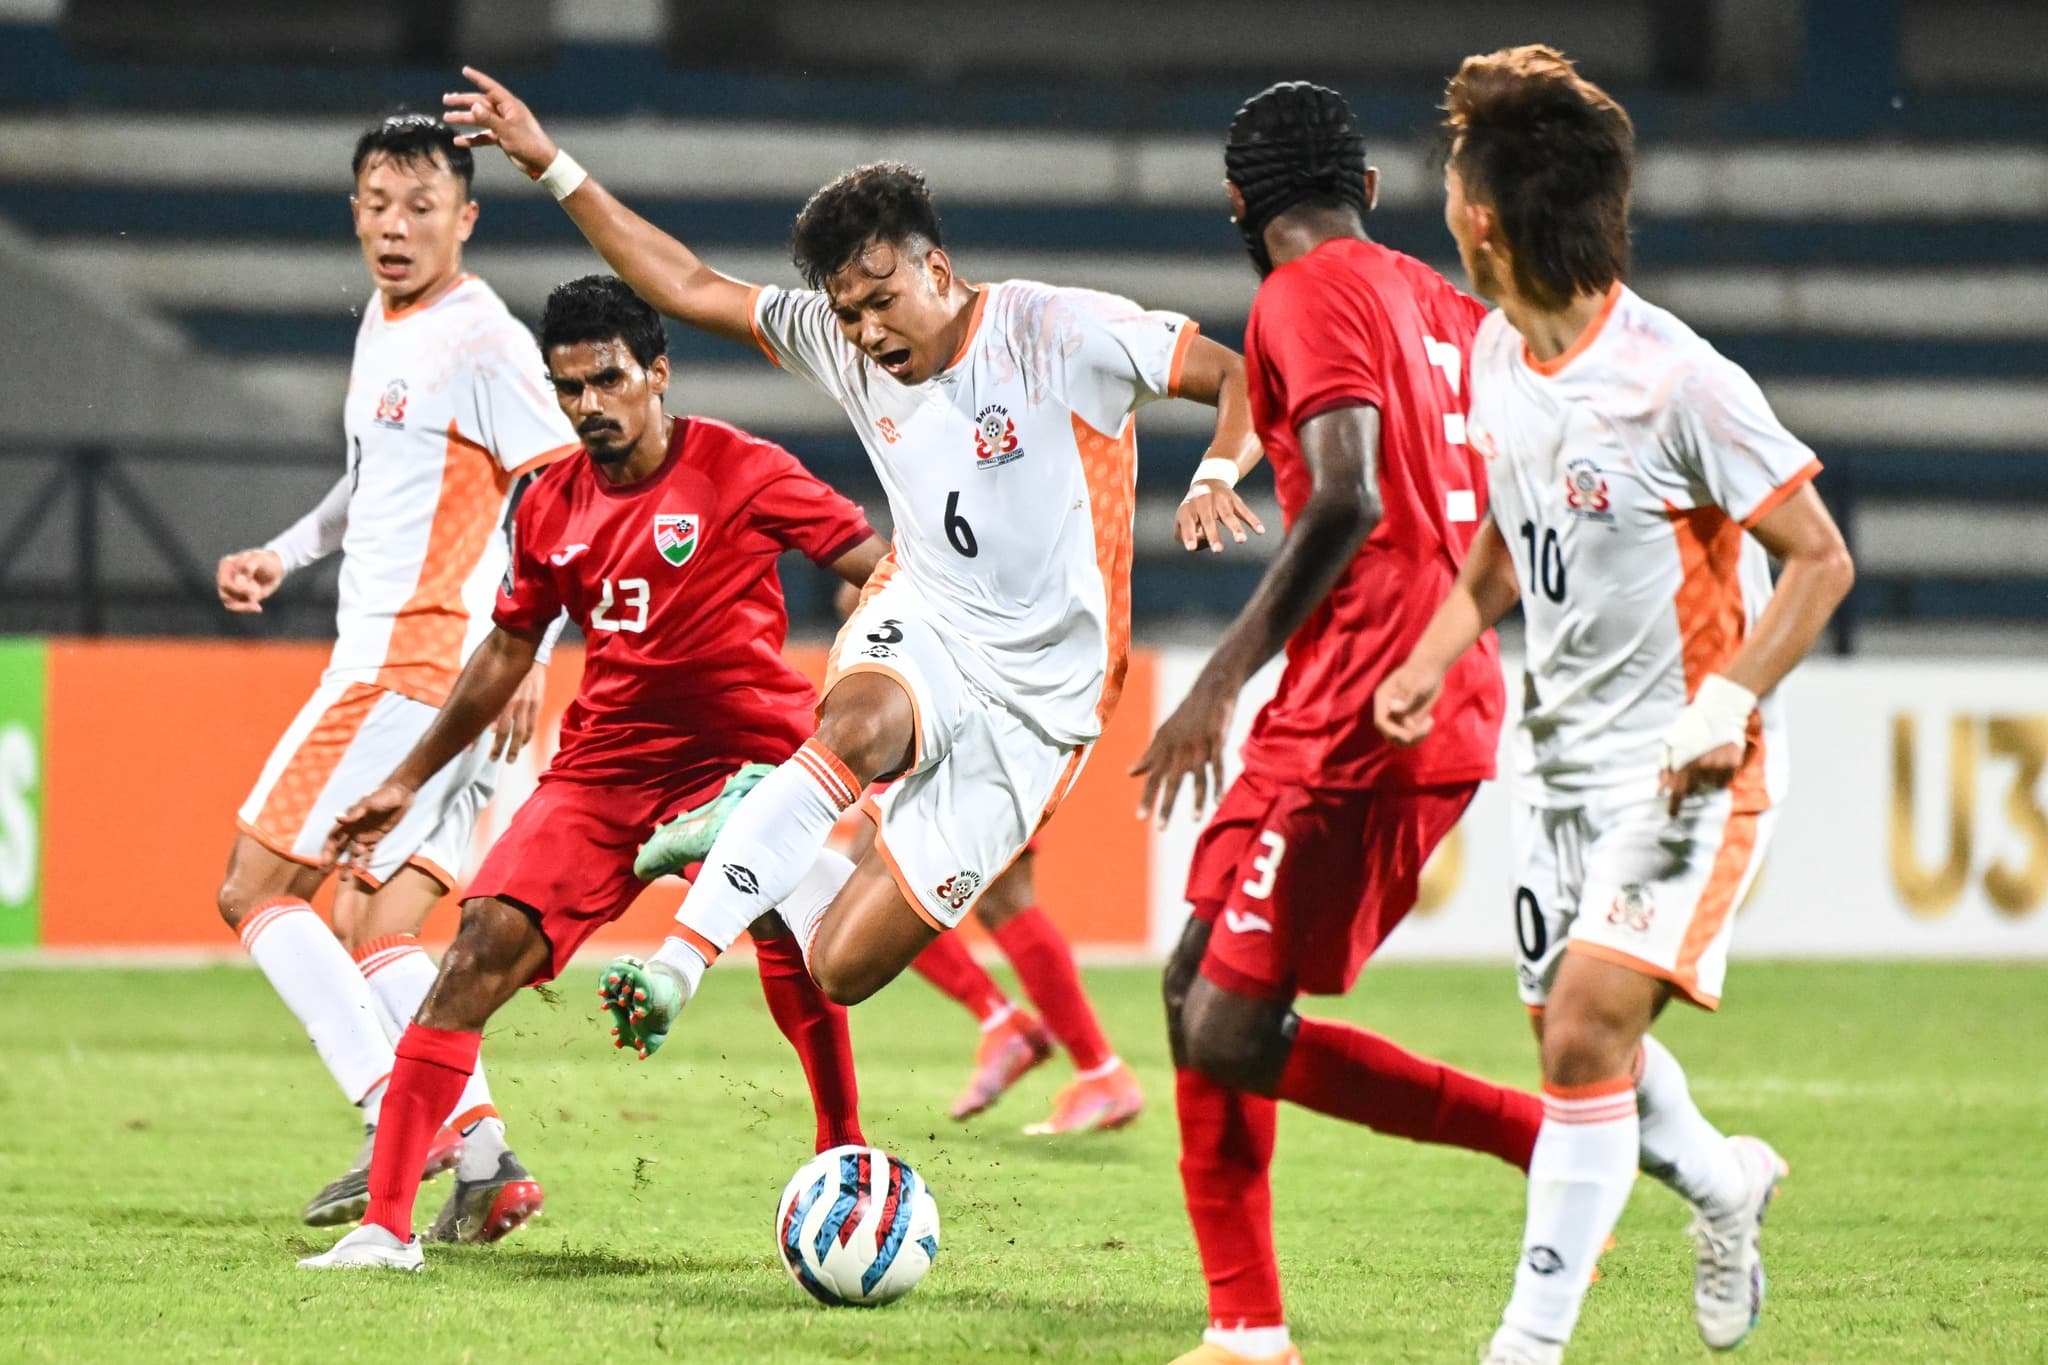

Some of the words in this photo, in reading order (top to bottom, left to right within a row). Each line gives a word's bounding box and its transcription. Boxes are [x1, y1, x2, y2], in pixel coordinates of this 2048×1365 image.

[976, 404, 1008, 424] BHUTAN
[944, 491, 978, 558] 6
[1521, 519, 1566, 604] 10
[590, 577, 650, 633] 23
[1242, 829, 1286, 900] 3
